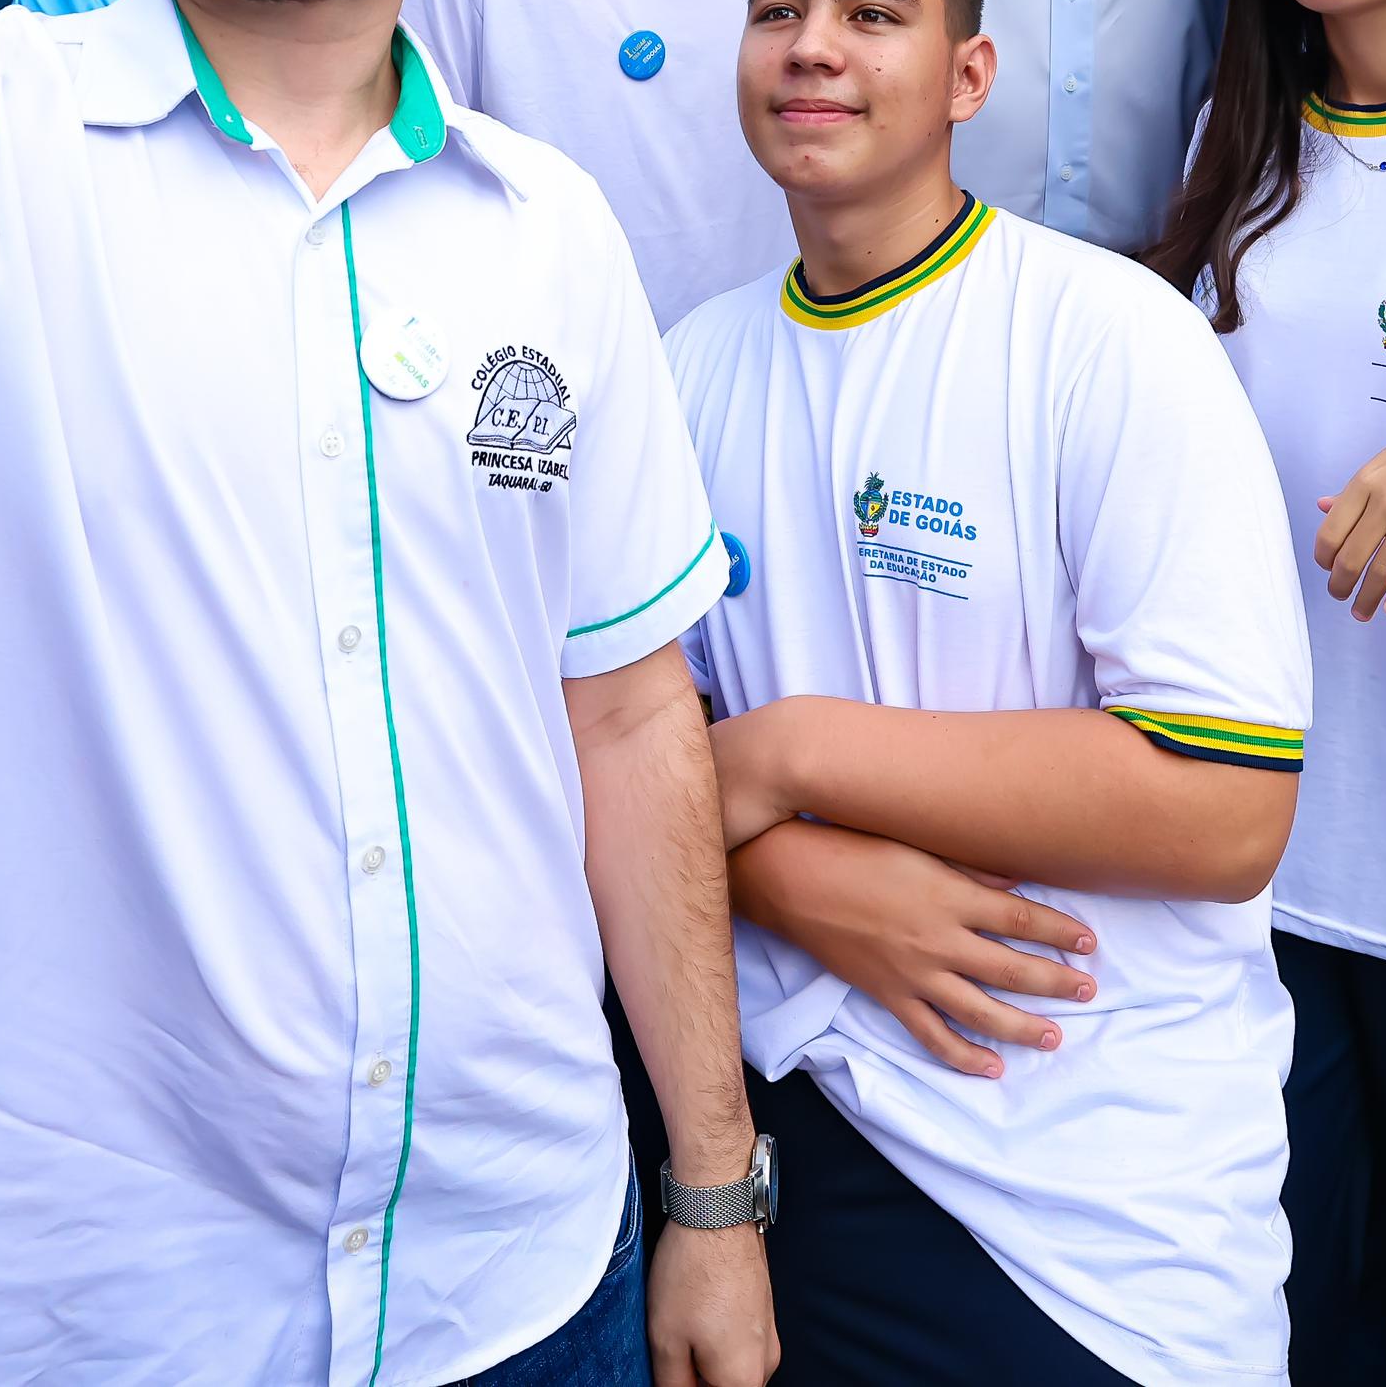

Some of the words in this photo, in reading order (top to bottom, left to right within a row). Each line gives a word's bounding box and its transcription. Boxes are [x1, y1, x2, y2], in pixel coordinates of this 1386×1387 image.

[471, 345, 517, 391] COLÉGIO
[522, 345, 571, 407] ESTADUAL
[472, 450, 534, 472] PRINCESA
[538, 459, 569, 480] IZABEL
[891, 490, 963, 517] ESTADO
[888, 509, 911, 527] DE
[915, 514, 977, 541] GOIÁS
[869, 559, 885, 570] DA
[906, 556, 919, 567] DE
[921, 559, 967, 579] ESTADO
